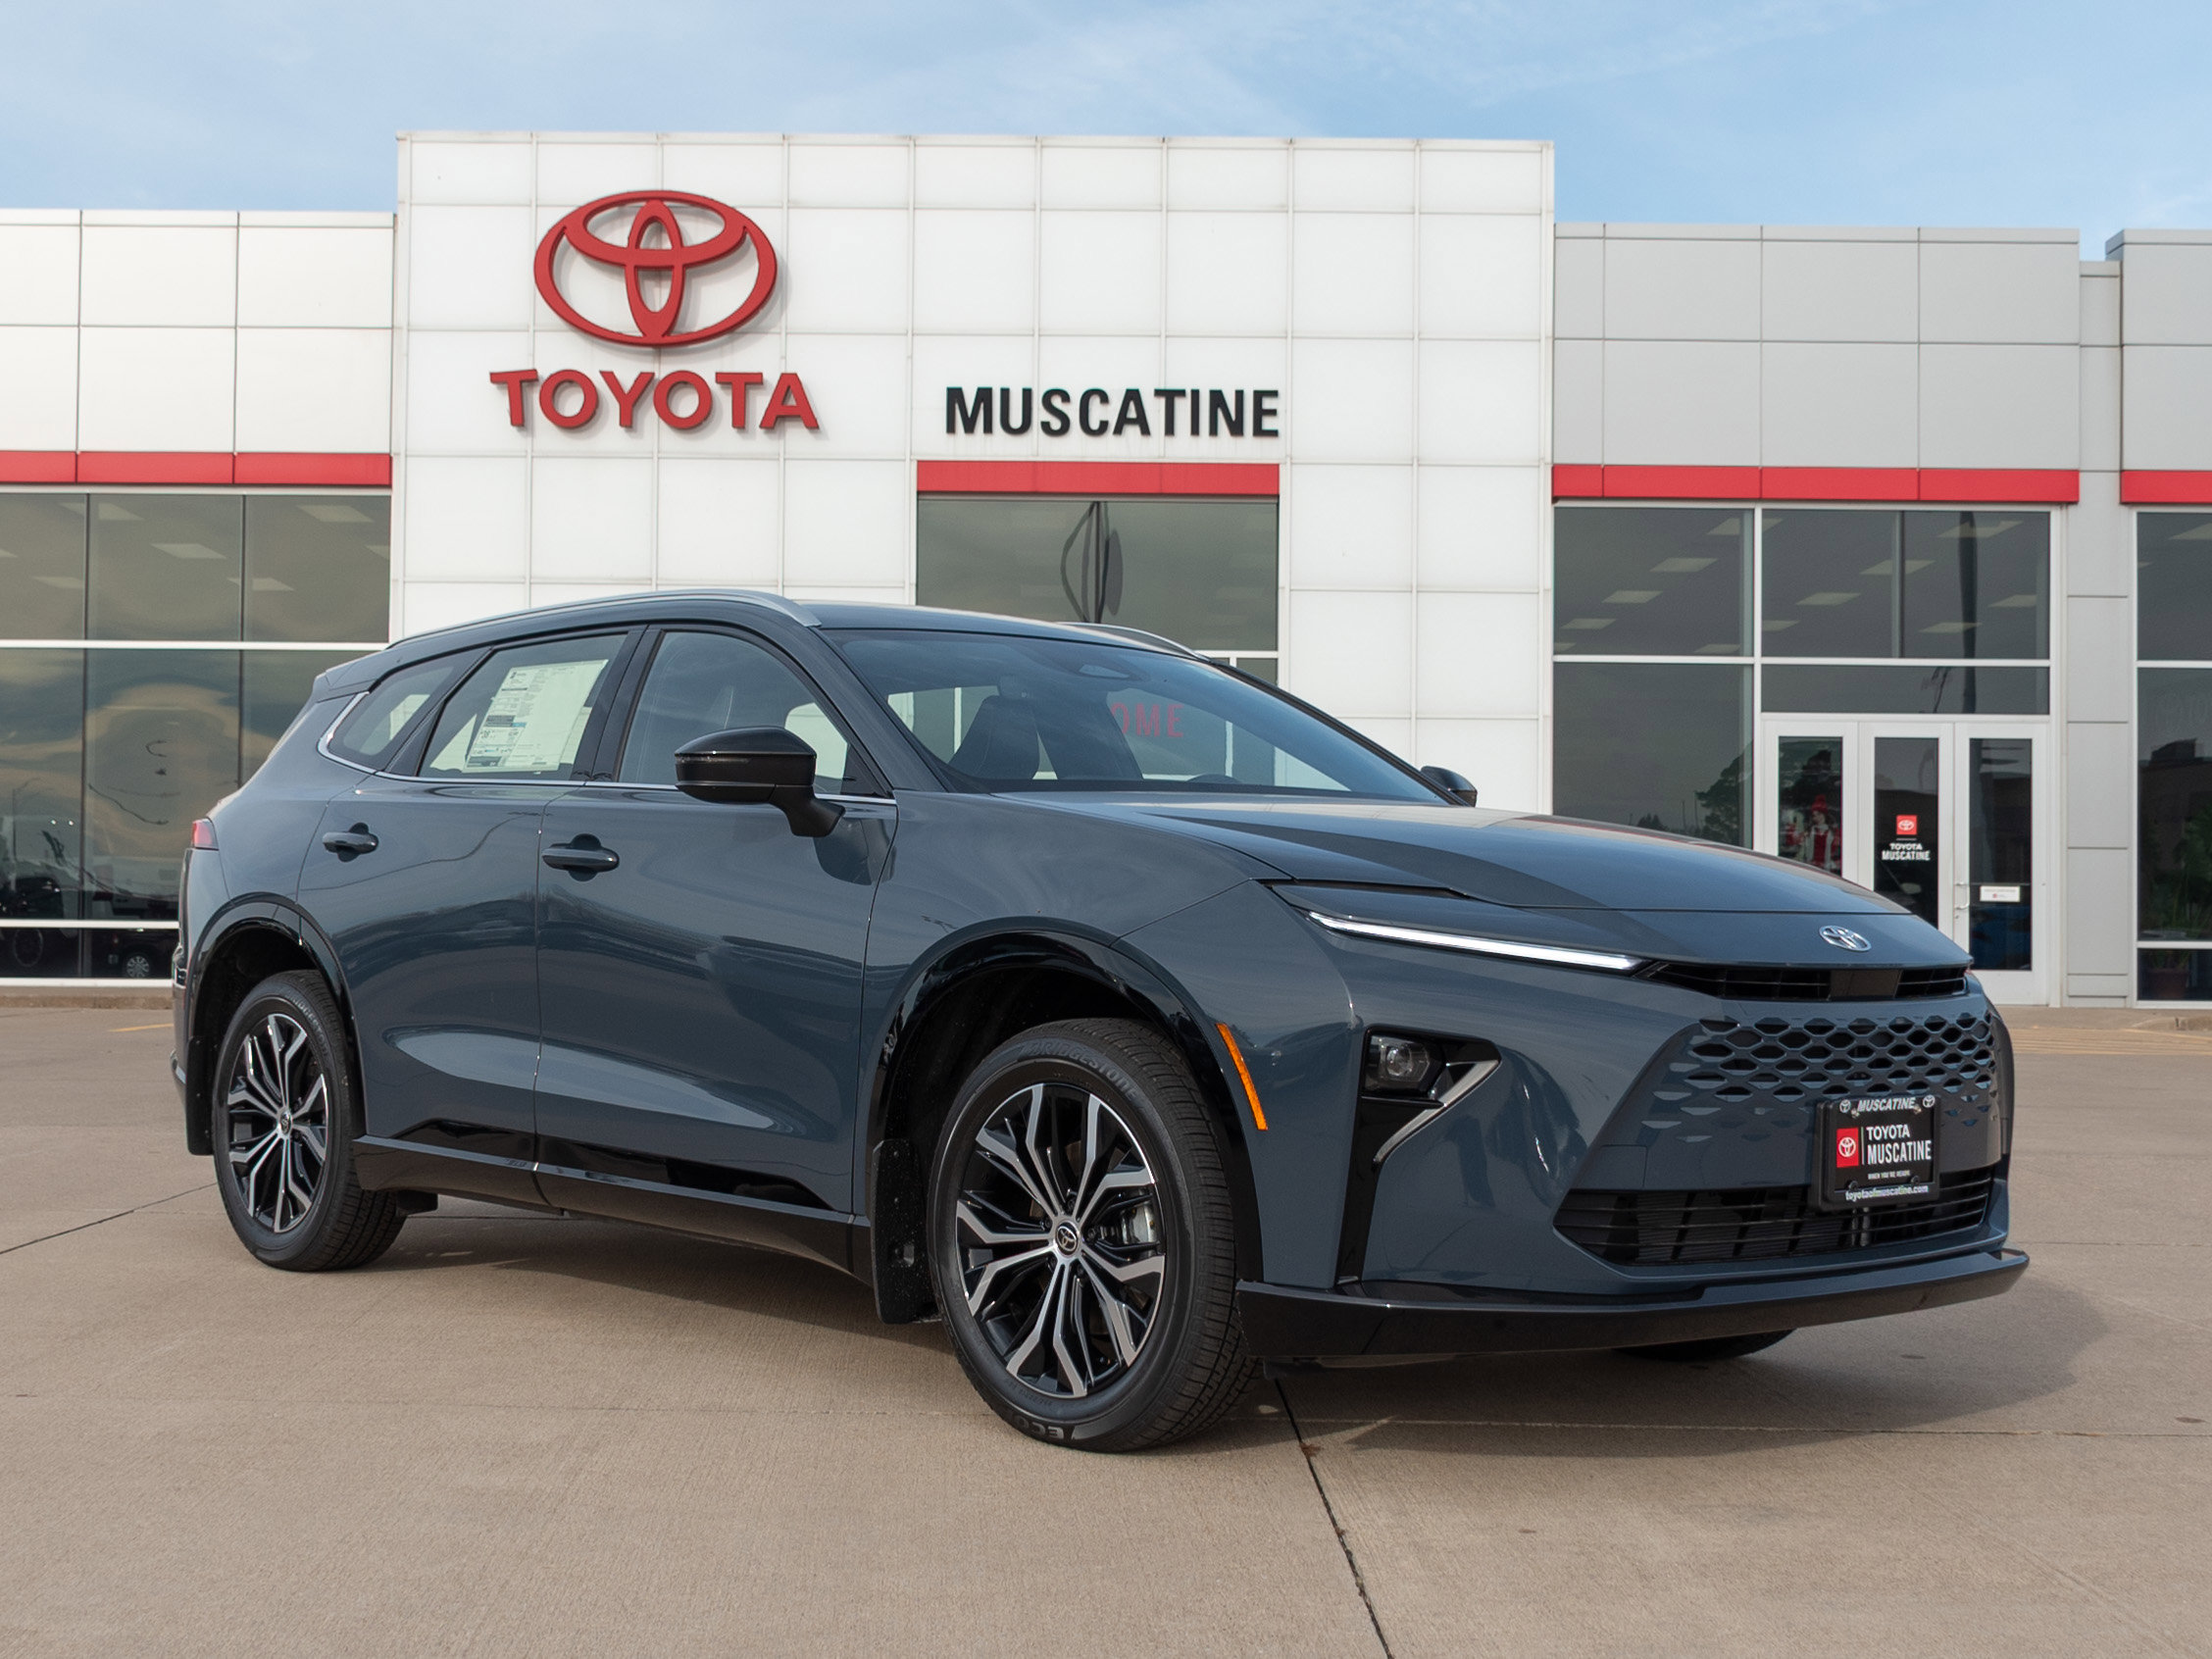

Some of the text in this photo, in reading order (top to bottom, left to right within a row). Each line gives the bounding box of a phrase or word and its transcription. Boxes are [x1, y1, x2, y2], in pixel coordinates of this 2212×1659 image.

[489, 369, 820, 429] TOYOTA
[946, 386, 1280, 438] MUSCATINE
[1889, 842, 1923, 851] TOYOTA
[1882, 849, 1931, 861] MUSCATINE
[1857, 1097, 1916, 1112] MUSCATINE
[1866, 1124, 1910, 1140] TOYOTA
[1867, 1140, 1932, 1164] MUSCATINE
[1845, 1185, 1929, 1202] toyotaofmuscatine.com
